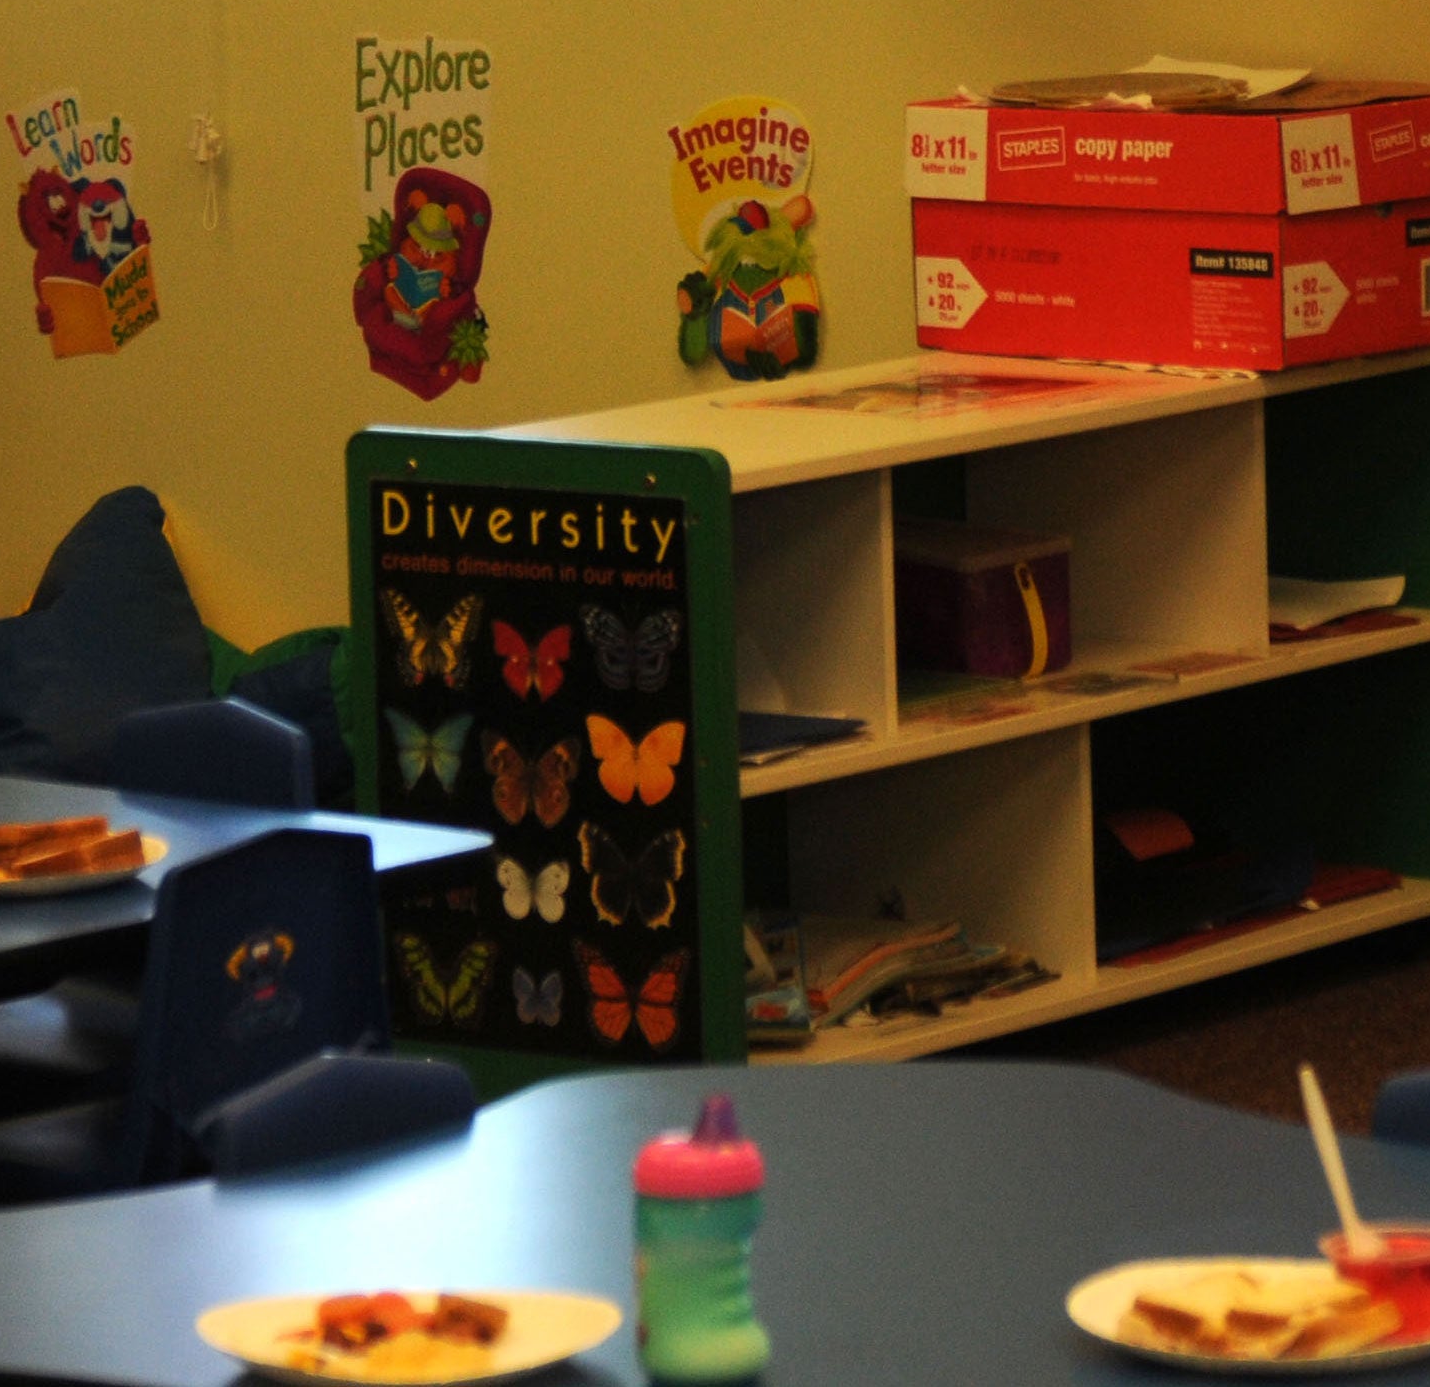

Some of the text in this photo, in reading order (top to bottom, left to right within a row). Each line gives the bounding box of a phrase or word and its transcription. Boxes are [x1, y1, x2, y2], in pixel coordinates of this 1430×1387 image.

[356, 35, 491, 113] Explore
[5, 97, 80, 158] Learn
[49, 116, 133, 178] Words
[667, 107, 810, 162] Imagine
[1002, 136, 1060, 159] STAPLES
[1373, 130, 1412, 153] STAPLES
[365, 111, 485, 192] Places
[1075, 136, 1174, 163] copy paper
[688, 152, 794, 194] Events
[936, 271, 955, 289] 92
[1302, 277, 1319, 295] 92
[937, 293, 956, 311] 20
[111, 300, 159, 347] School
[381, 489, 677, 564] Diversity
[381, 551, 677, 591] creates dimension in our world.
